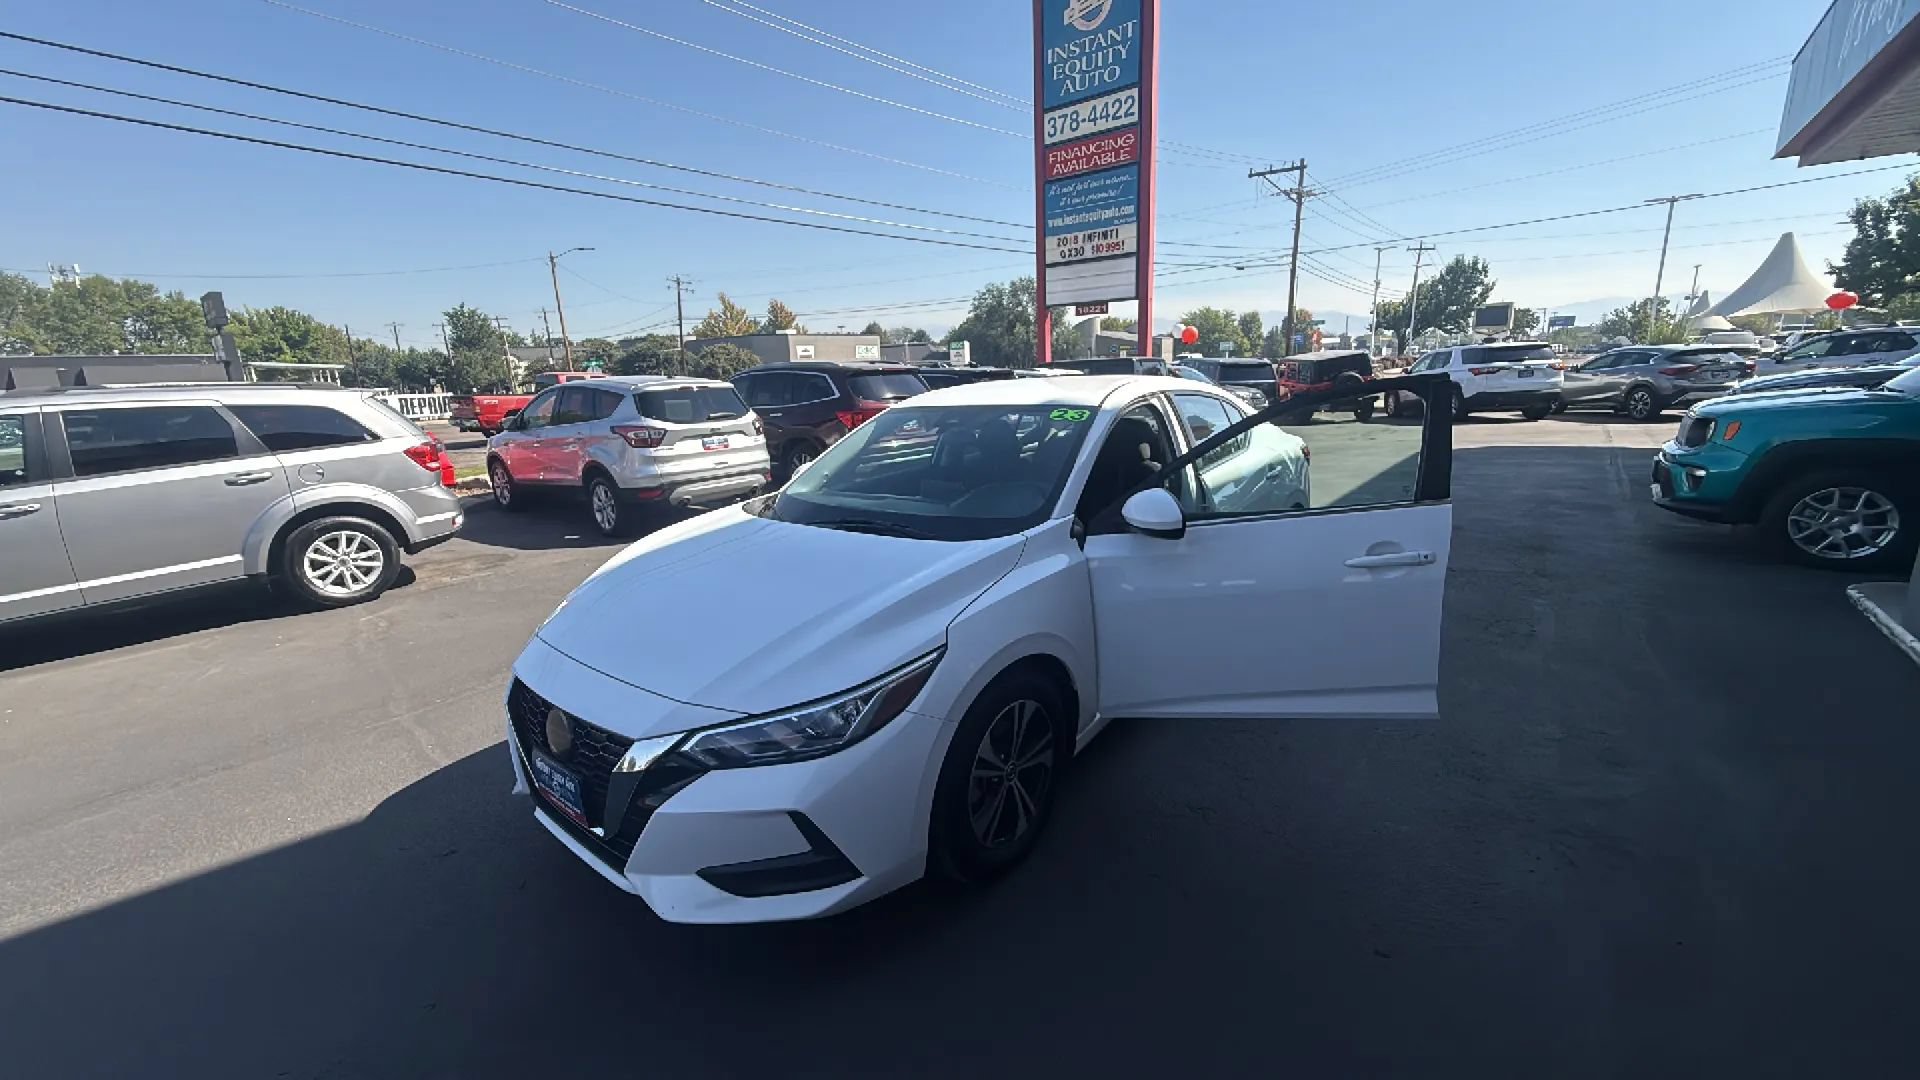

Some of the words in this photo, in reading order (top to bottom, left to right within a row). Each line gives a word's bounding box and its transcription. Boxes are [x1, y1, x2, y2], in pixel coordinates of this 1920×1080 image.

[1047, 20, 1137, 64] INSTANT
[1053, 41, 1131, 80] EQUITY
[1060, 65, 1120, 96] AUTO
[1047, 95, 1136, 138] 378-4422
[1049, 133, 1135, 164] FINANCING
[1052, 147, 1131, 175] AVAILABLE
[1057, 235, 1079, 247] 2018
